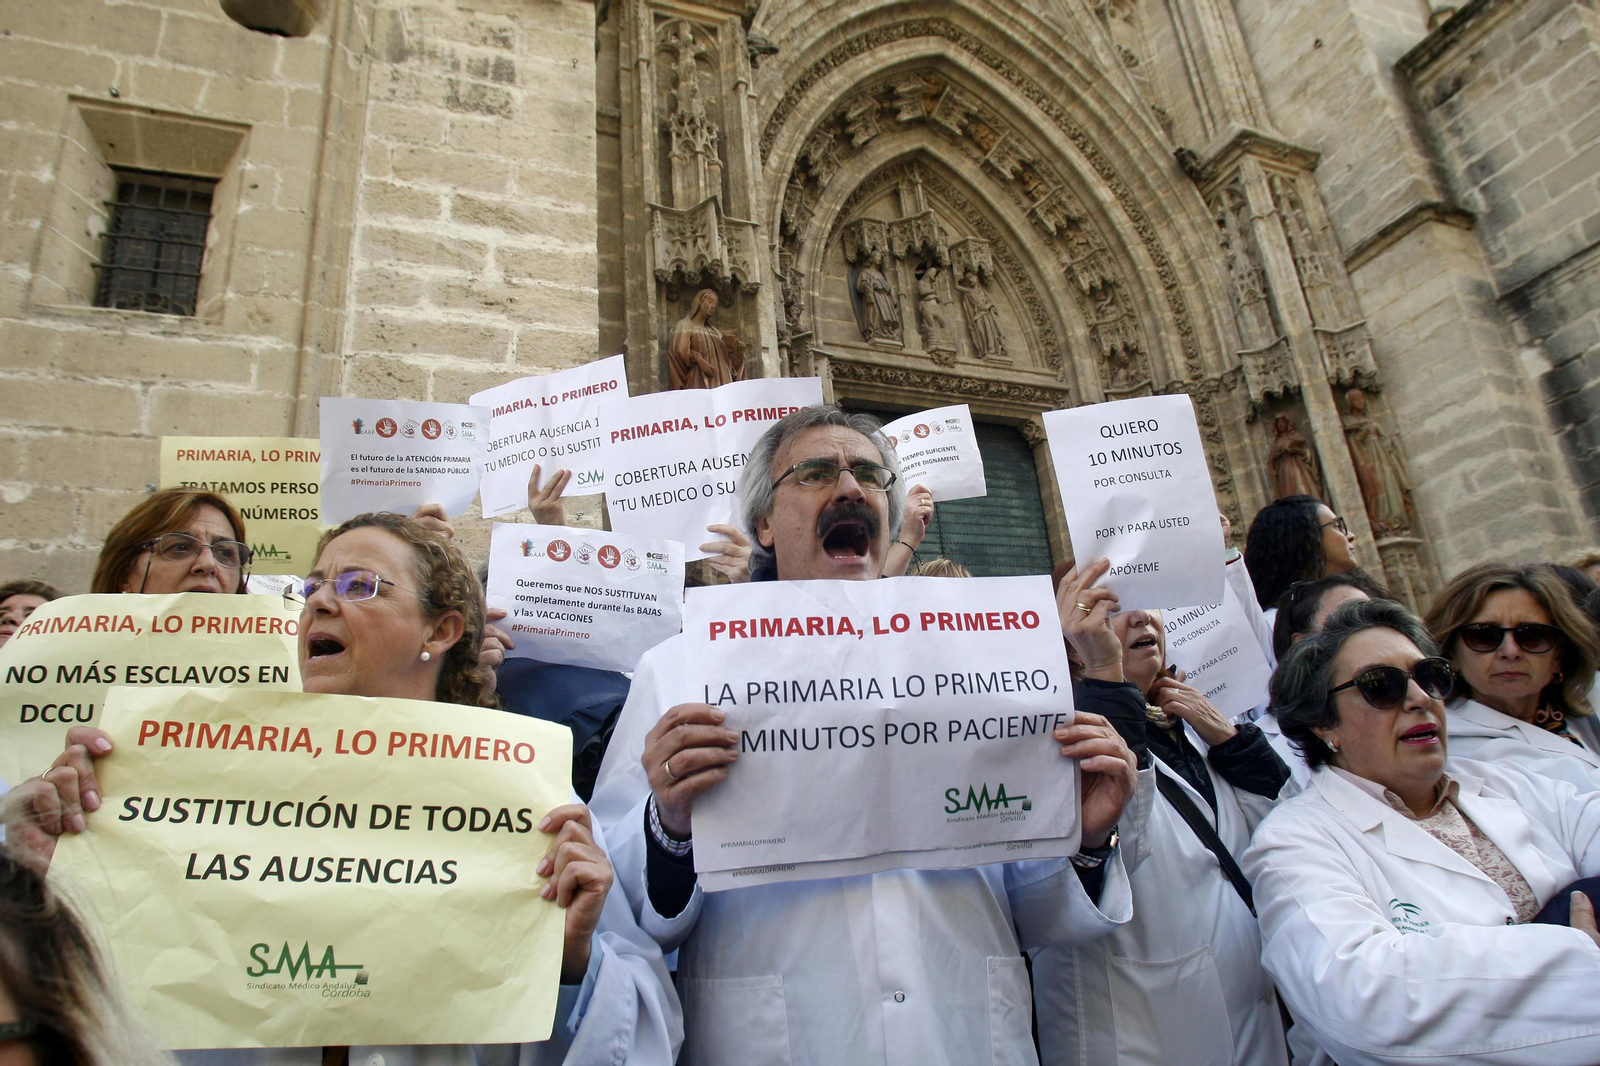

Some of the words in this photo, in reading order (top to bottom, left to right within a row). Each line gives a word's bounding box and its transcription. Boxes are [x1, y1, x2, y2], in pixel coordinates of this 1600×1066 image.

[490, 398, 537, 418] IMARIA,
[542, 395, 558, 406] LO
[562, 379, 618, 402] PRIMERO
[540, 420, 592, 439] AUSENCIA
[610, 418, 698, 444] PRIMARIA,
[704, 414, 726, 428] LO
[732, 406, 810, 424] PRIMER
[1100, 419, 1159, 438] QUIERO
[176, 449, 256, 464] PRIMARIA,
[261, 450, 280, 462] LO
[285, 450, 321, 463] PRIM
[405, 454, 442, 462] ATENCIÓN
[484, 461, 496, 473] TU
[498, 449, 536, 469] MEDICO
[538, 447, 547, 457] O
[550, 446, 565, 457] SU
[568, 437, 600, 454] SUSTIT
[1088, 452, 1107, 466] 10
[1111, 442, 1182, 462] MINUTOS
[350, 479, 421, 487] #PrimariaPrimero
[614, 460, 697, 487] COBERTURA
[1094, 477, 1116, 488] POR
[1118, 469, 1172, 484] CONSULTA
[270, 482, 319, 494] PERSO
[642, 487, 698, 508] MEDICO
[702, 484, 713, 498] O
[718, 480, 736, 495] SU
[240, 505, 318, 520] NÚMEROS
[1096, 527, 1116, 539] POR
[1118, 526, 1124, 534] Y
[1127, 520, 1156, 533] PARA
[1159, 517, 1190, 529] USTED
[1110, 562, 1159, 576] APÓYEME
[516, 578, 563, 591] Queremos
[566, 585, 582, 594] que
[584, 585, 603, 596] NOS
[605, 588, 658, 602] SUSTITUYAN
[513, 608, 520, 617] y
[521, 608, 534, 617] las
[536, 610, 593, 623] VACACIONES
[515, 593, 585, 609] completamente
[588, 601, 621, 613] durante
[623, 604, 634, 614] las
[637, 606, 662, 617] BAJAS
[16, 615, 143, 639] PRIMARIA,
[152, 615, 183, 633] LO
[191, 616, 299, 636] PRIMERO
[512, 624, 590, 639] #PrimariaPrimero
[709, 615, 864, 641] PRIMARIA,
[873, 613, 910, 635] LO
[921, 610, 1040, 632] PRIMERO
[1164, 621, 1177, 634] 10
[1172, 636, 1187, 648] POR
[1187, 619, 1221, 640] CONSULTA
[1202, 658, 1218, 671] PARA
[1218, 646, 1238, 661] USTED
[5, 665, 47, 684] NO
[56, 660, 116, 684] MÁS
[125, 665, 250, 684] ESCLAVOS
[258, 666, 289, 683] EN
[704, 683, 736, 706] LA
[747, 677, 883, 705] PRIMARIA
[892, 675, 926, 698] LO
[935, 669, 1058, 696] PRIMERO,
[20, 703, 94, 723] DCCU
[137, 720, 322, 758] PRIMARIA,
[335, 728, 378, 755] LO
[387, 732, 536, 765] PRIMERO
[741, 724, 875, 753] MINUTOS
[885, 722, 938, 745] POR
[948, 713, 1066, 742] PACIENTE
[944, 782, 1027, 814] SMA
[118, 796, 362, 829] SUSTITUCIÓN
[369, 804, 414, 830] DE
[423, 805, 532, 834] TODAS
[1000, 815, 1026, 823] Sevilla
[721, 838, 786, 848] #PRIMARIALOPRIMERO
[1007, 841, 1032, 851] Sevilla
[185, 853, 250, 881] LAS
[260, 854, 457, 885] AUSENCIAS
[732, 865, 796, 878] #PRIMARIALOPRIMERO
[247, 940, 363, 982] SMA
[322, 988, 371, 998] Córdoba
